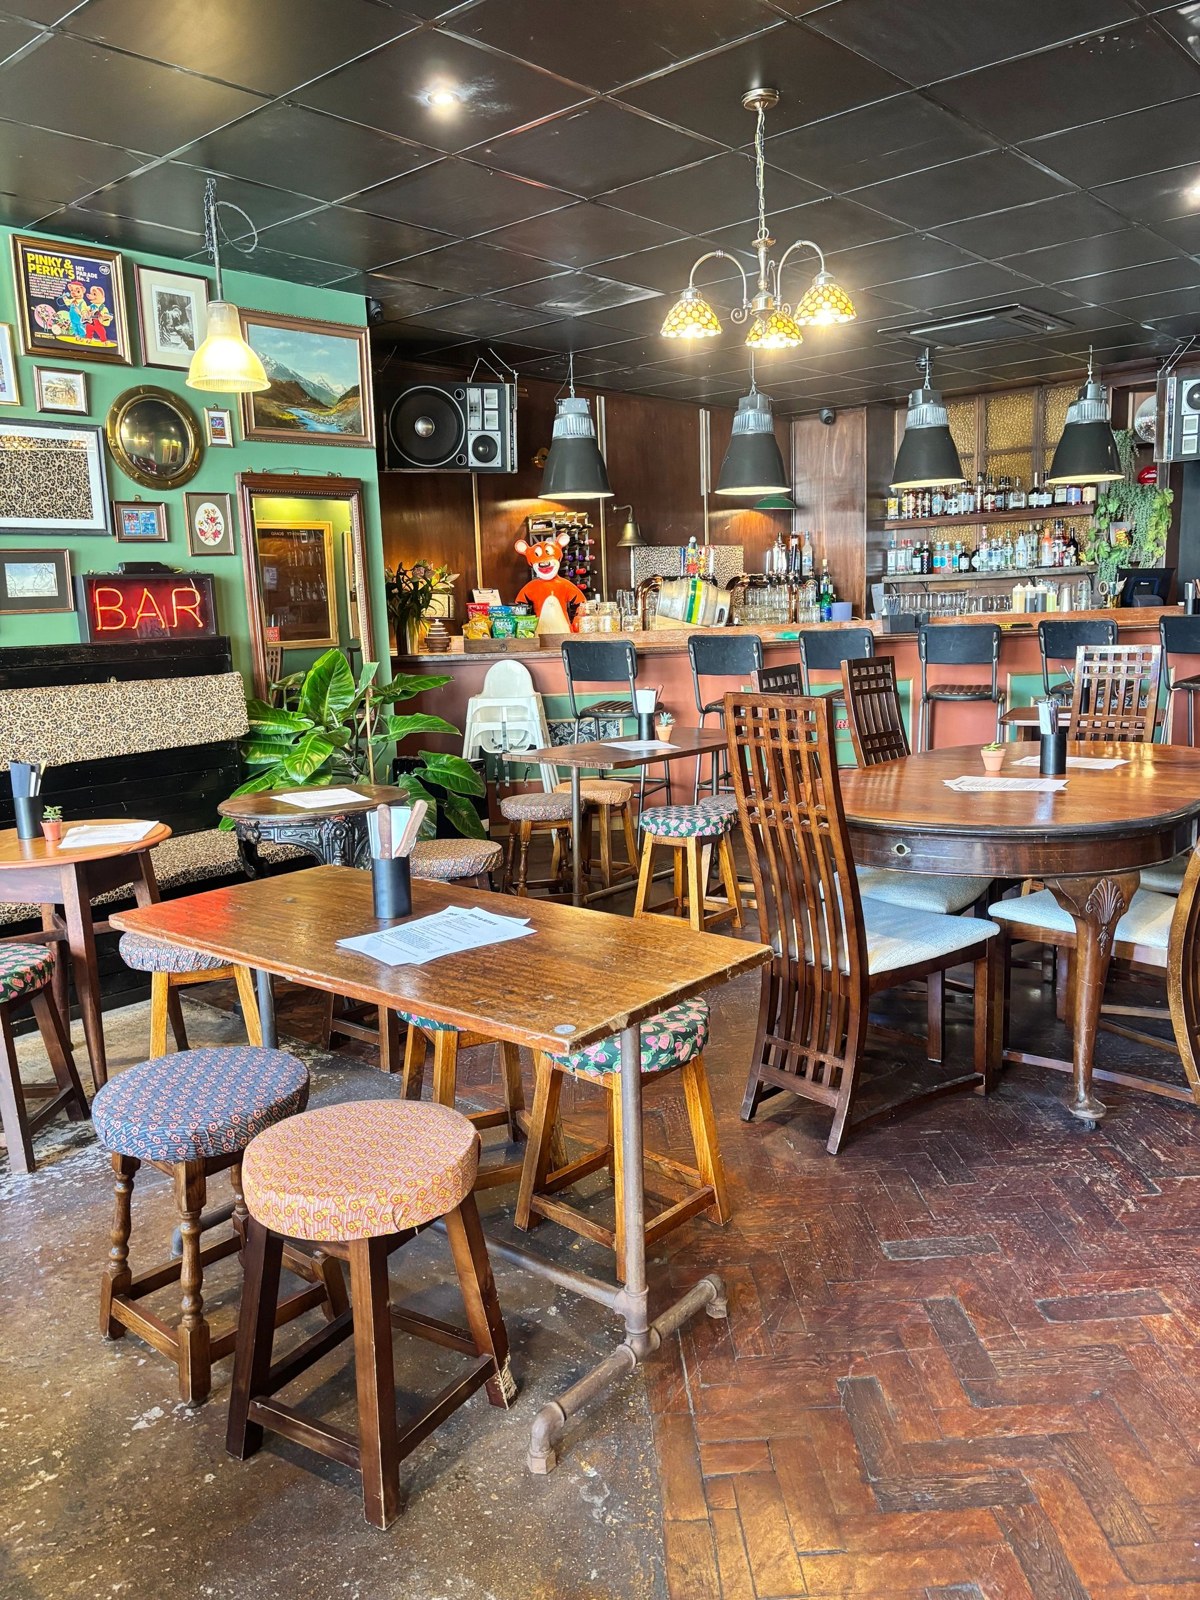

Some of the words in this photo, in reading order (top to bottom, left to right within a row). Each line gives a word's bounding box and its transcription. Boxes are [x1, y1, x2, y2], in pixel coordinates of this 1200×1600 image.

[27, 252, 63, 268] PINKY
[64, 259, 74, 270] &
[27, 262, 75, 280] PERKY'S
[76, 271, 98, 279] PARADE
[95, 587, 204, 631] BAR
